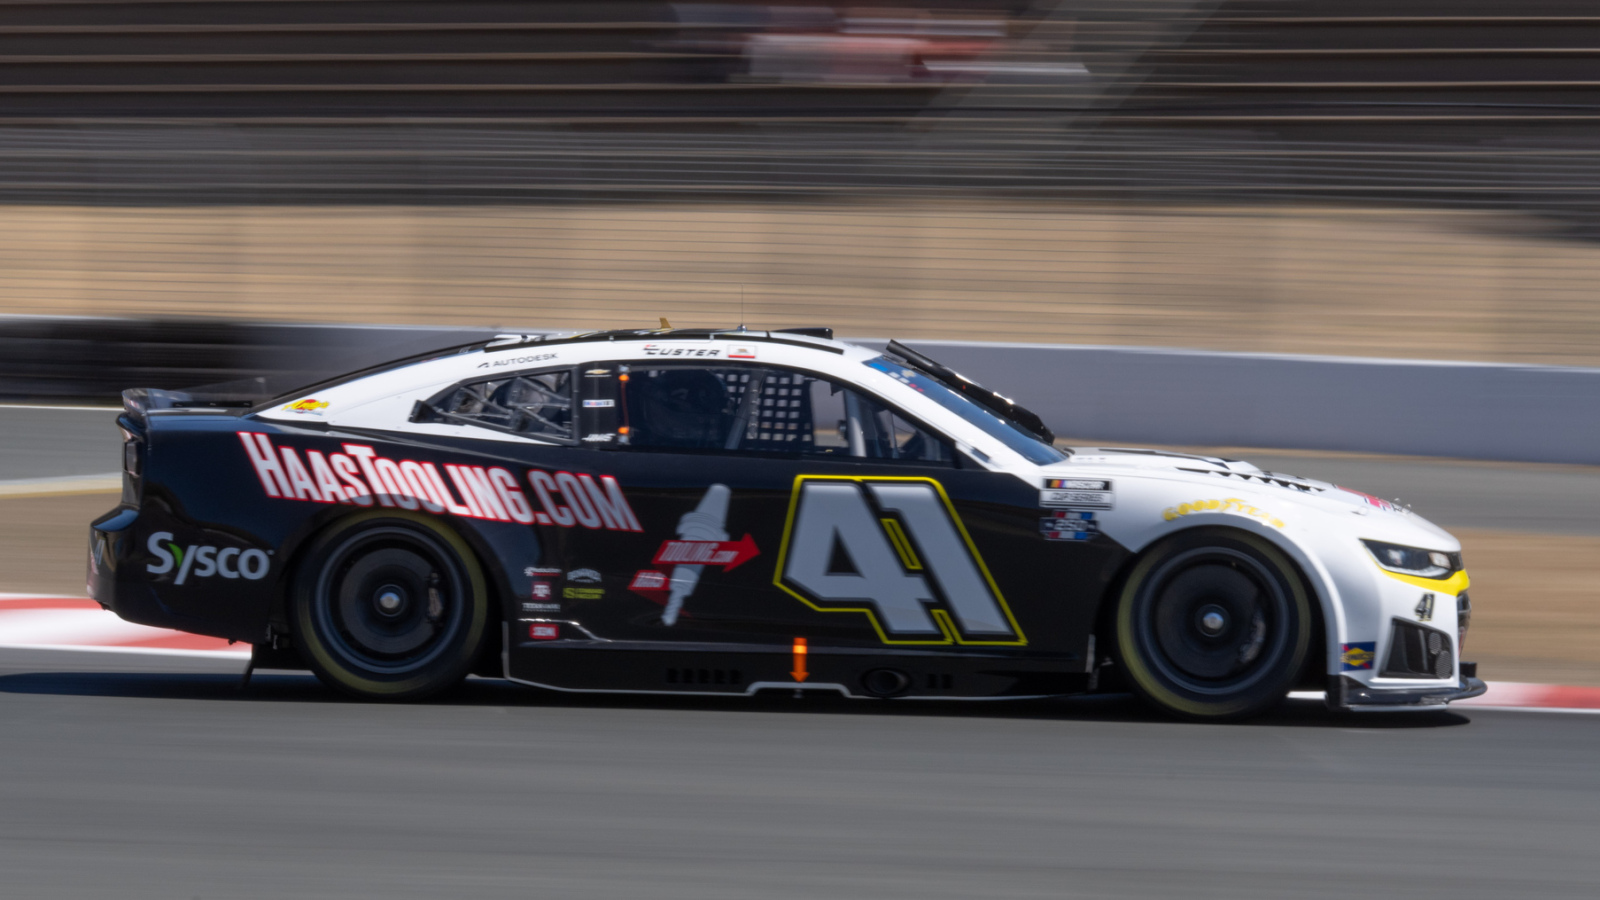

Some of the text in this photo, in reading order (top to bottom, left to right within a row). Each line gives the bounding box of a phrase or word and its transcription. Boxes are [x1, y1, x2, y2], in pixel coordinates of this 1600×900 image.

[493, 353, 558, 367] AUTODESK
[642, 344, 721, 357] CUSTER
[147, 531, 270, 585] Sysco
[774, 475, 1028, 645] 41
[1415, 593, 1435, 622] 41
